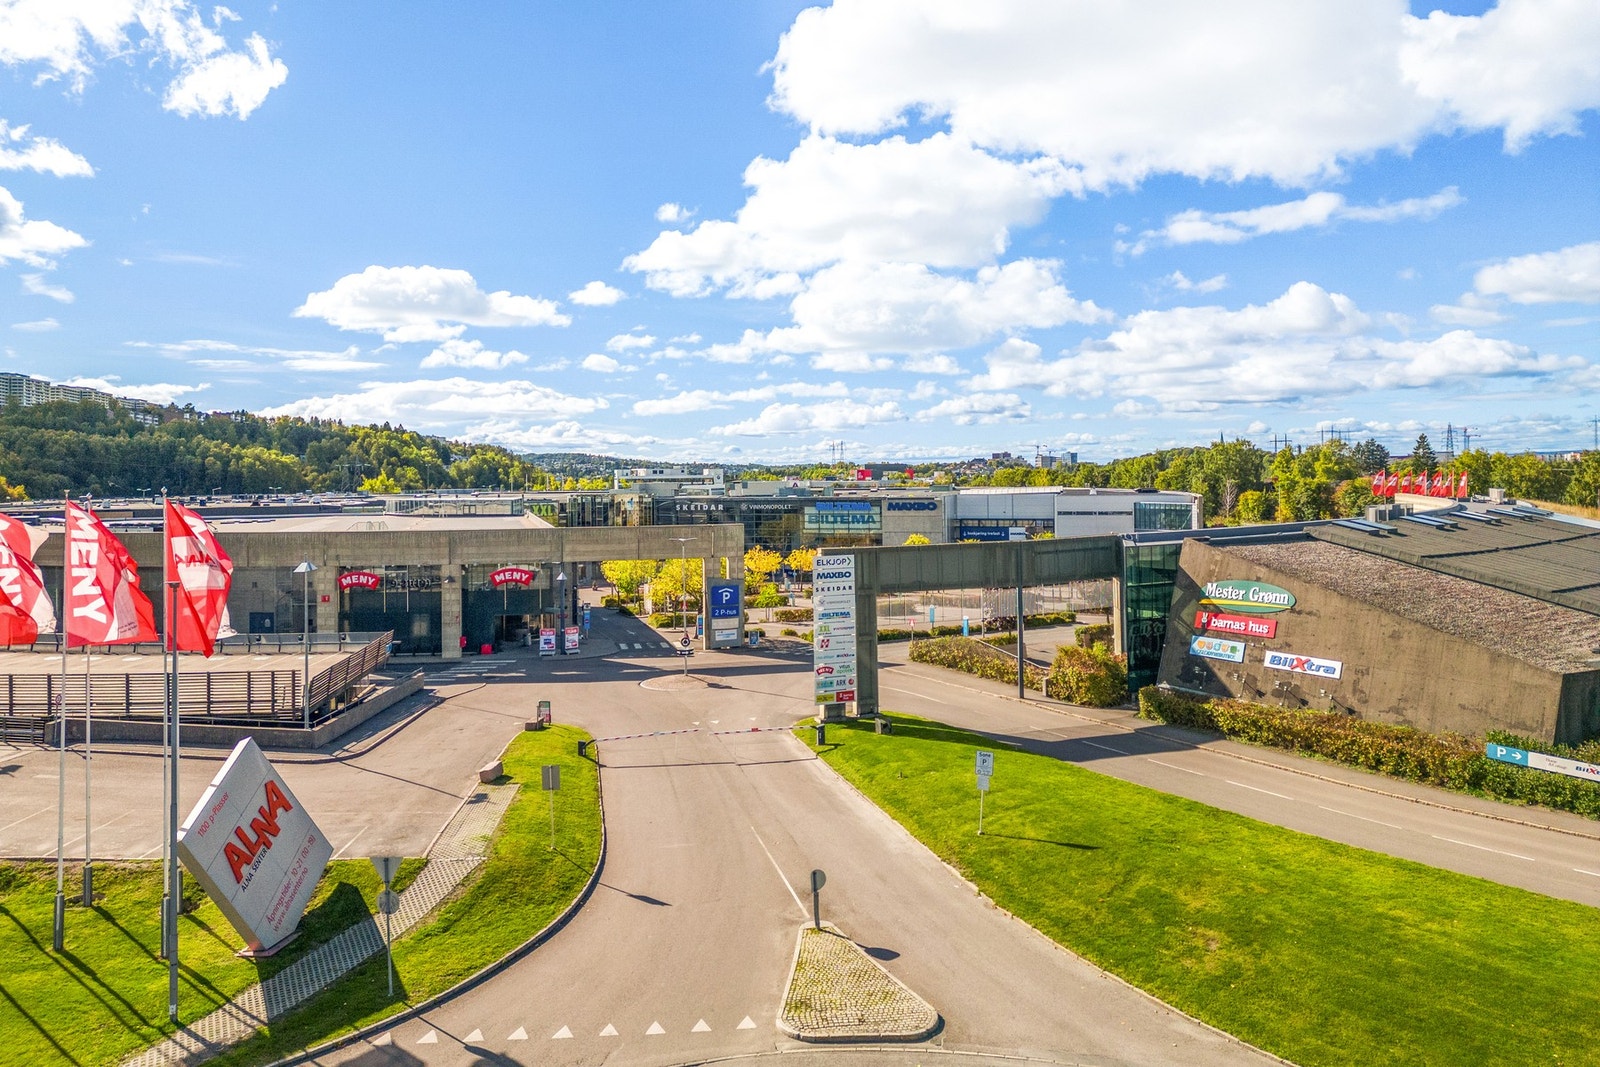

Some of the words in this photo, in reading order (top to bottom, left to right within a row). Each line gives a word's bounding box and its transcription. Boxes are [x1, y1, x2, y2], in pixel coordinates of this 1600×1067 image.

[815, 501, 872, 511] BILTEMA
[887, 502, 938, 511] MAXBO
[807, 514, 877, 524] BILTEMA
[69, 507, 107, 624] MENY
[341, 575, 376, 586] MENY
[494, 571, 530, 582] MENY
[816, 571, 852, 580] MAXBO
[723, 592, 730, 603] P
[1206, 582, 1246, 600] Mester
[1249, 586, 1290, 605] Grønn
[1211, 616, 1246, 631] barnas
[1248, 620, 1270, 634] hus
[1268, 654, 1337, 675] BilXtra
[836, 679, 847, 687] ARK
[1497, 746, 1506, 757] P
[197, 820, 211, 838] 1100
[209, 791, 229, 824] p-Plasser
[223, 780, 294, 884] ALNA
[241, 872, 254, 893] ALNA
[252, 847, 268, 873] SENTER
